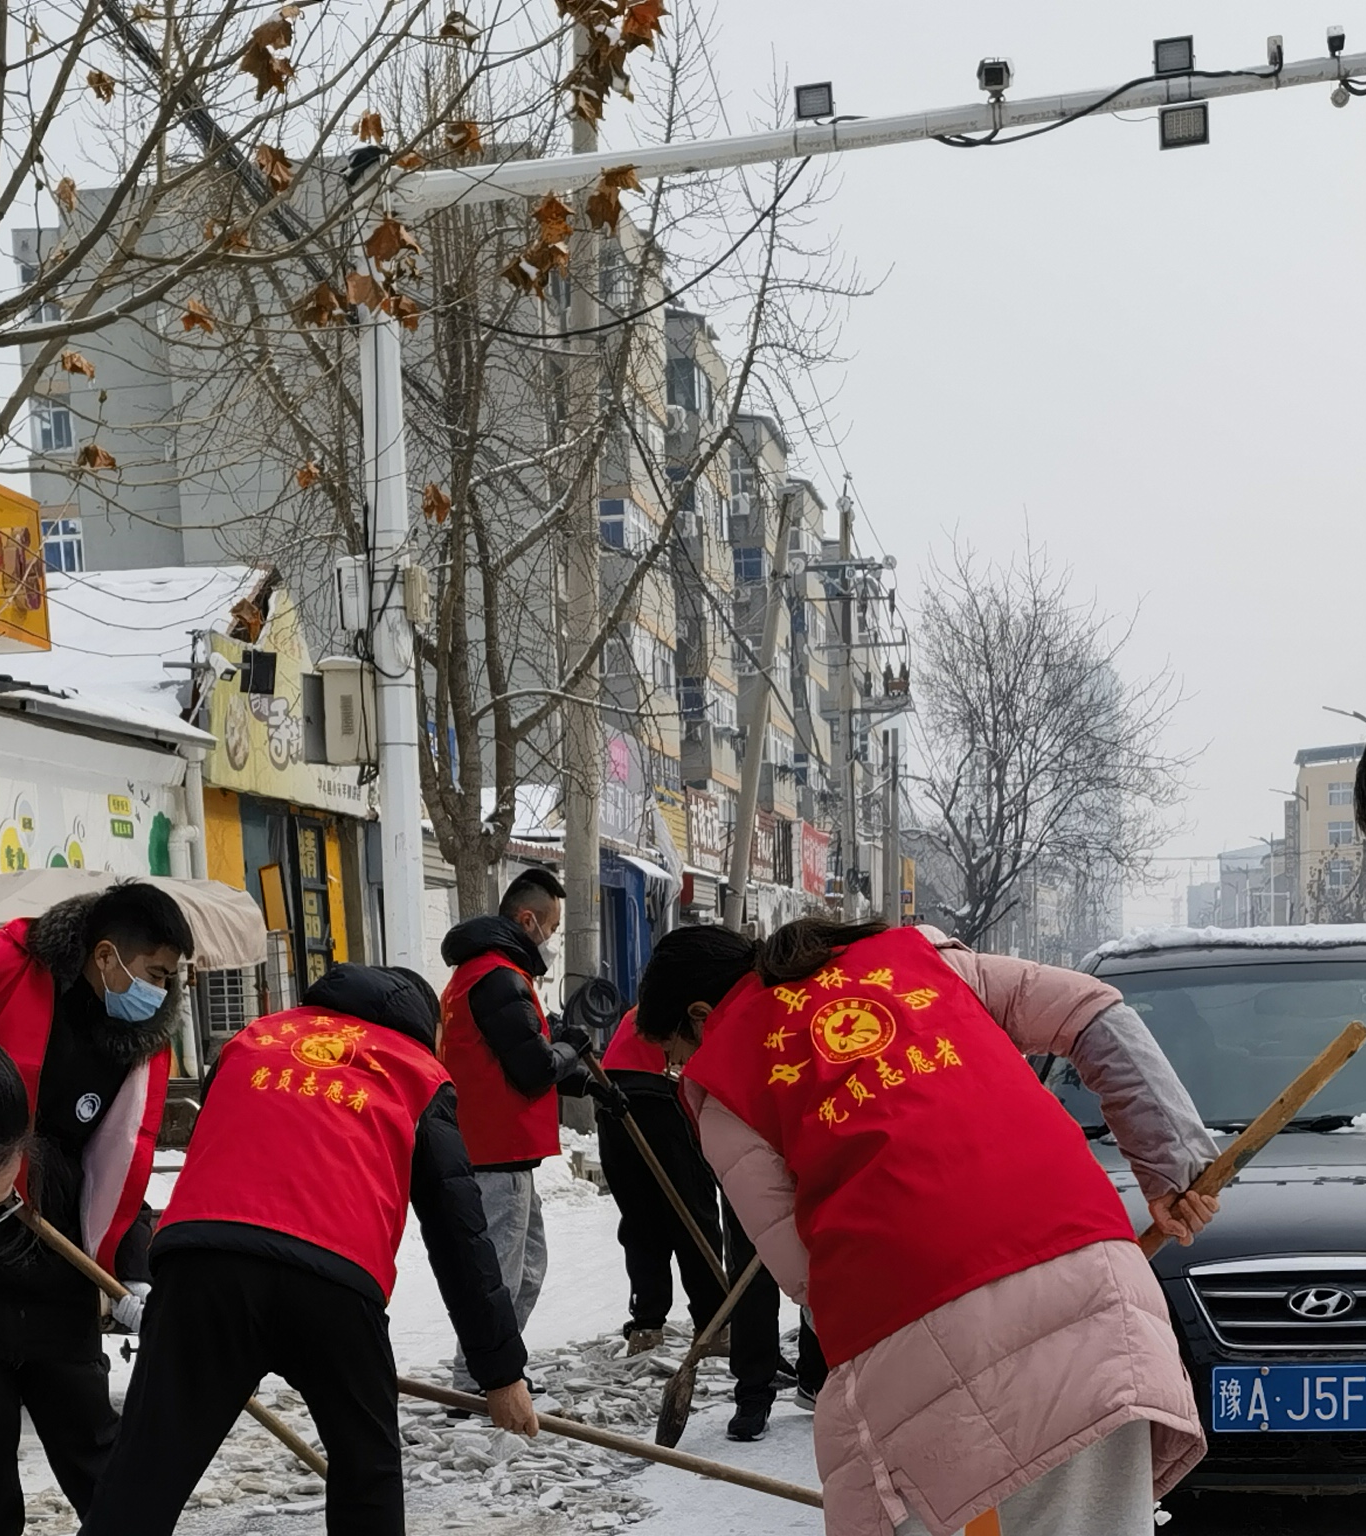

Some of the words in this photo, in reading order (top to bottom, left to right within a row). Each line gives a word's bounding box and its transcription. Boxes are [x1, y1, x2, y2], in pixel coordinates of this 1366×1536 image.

[250, 1066, 369, 1114] 党员志愿者
[818, 1036, 963, 1129] 党员志愿者
